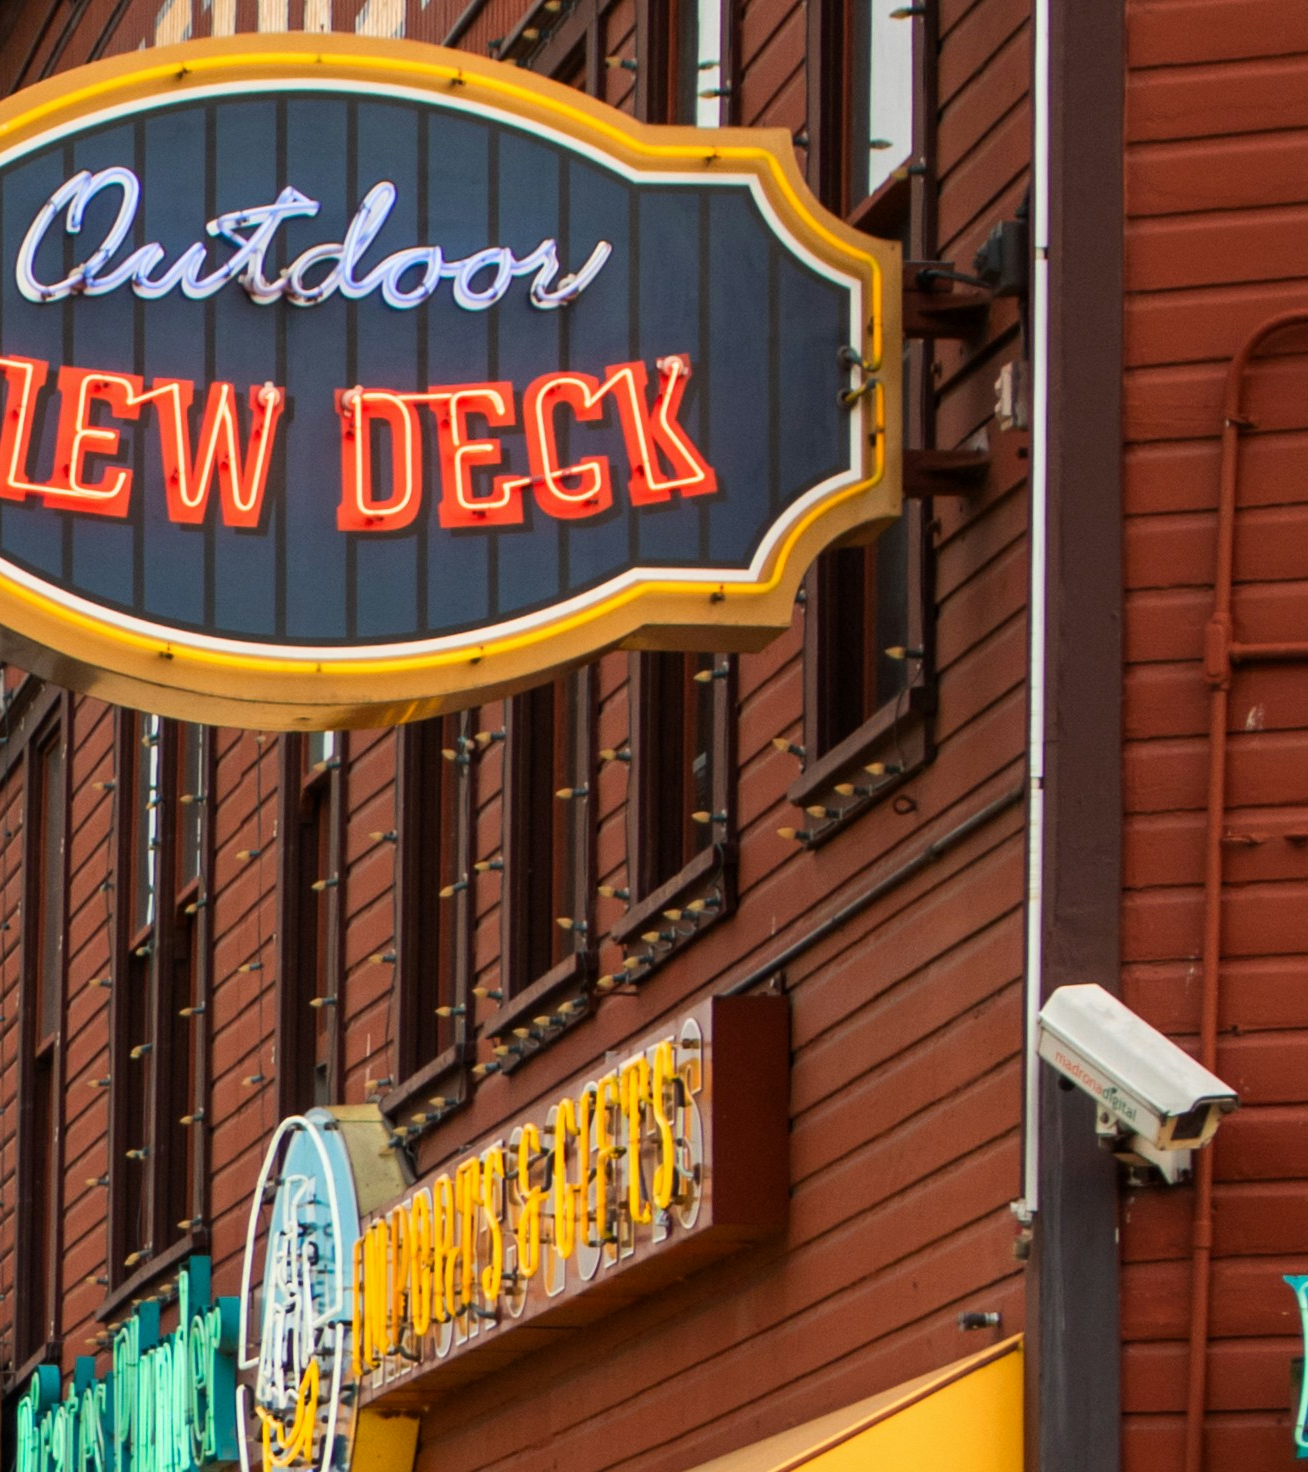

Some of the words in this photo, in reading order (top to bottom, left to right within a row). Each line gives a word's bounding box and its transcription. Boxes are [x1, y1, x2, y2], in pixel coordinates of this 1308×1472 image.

[16, 166, 613, 311] Outdoor
[335, 352, 717, 532] DECK
[351, 1140, 507, 1378] IMPORTS
[553, 1036, 687, 1268] GIFTS
